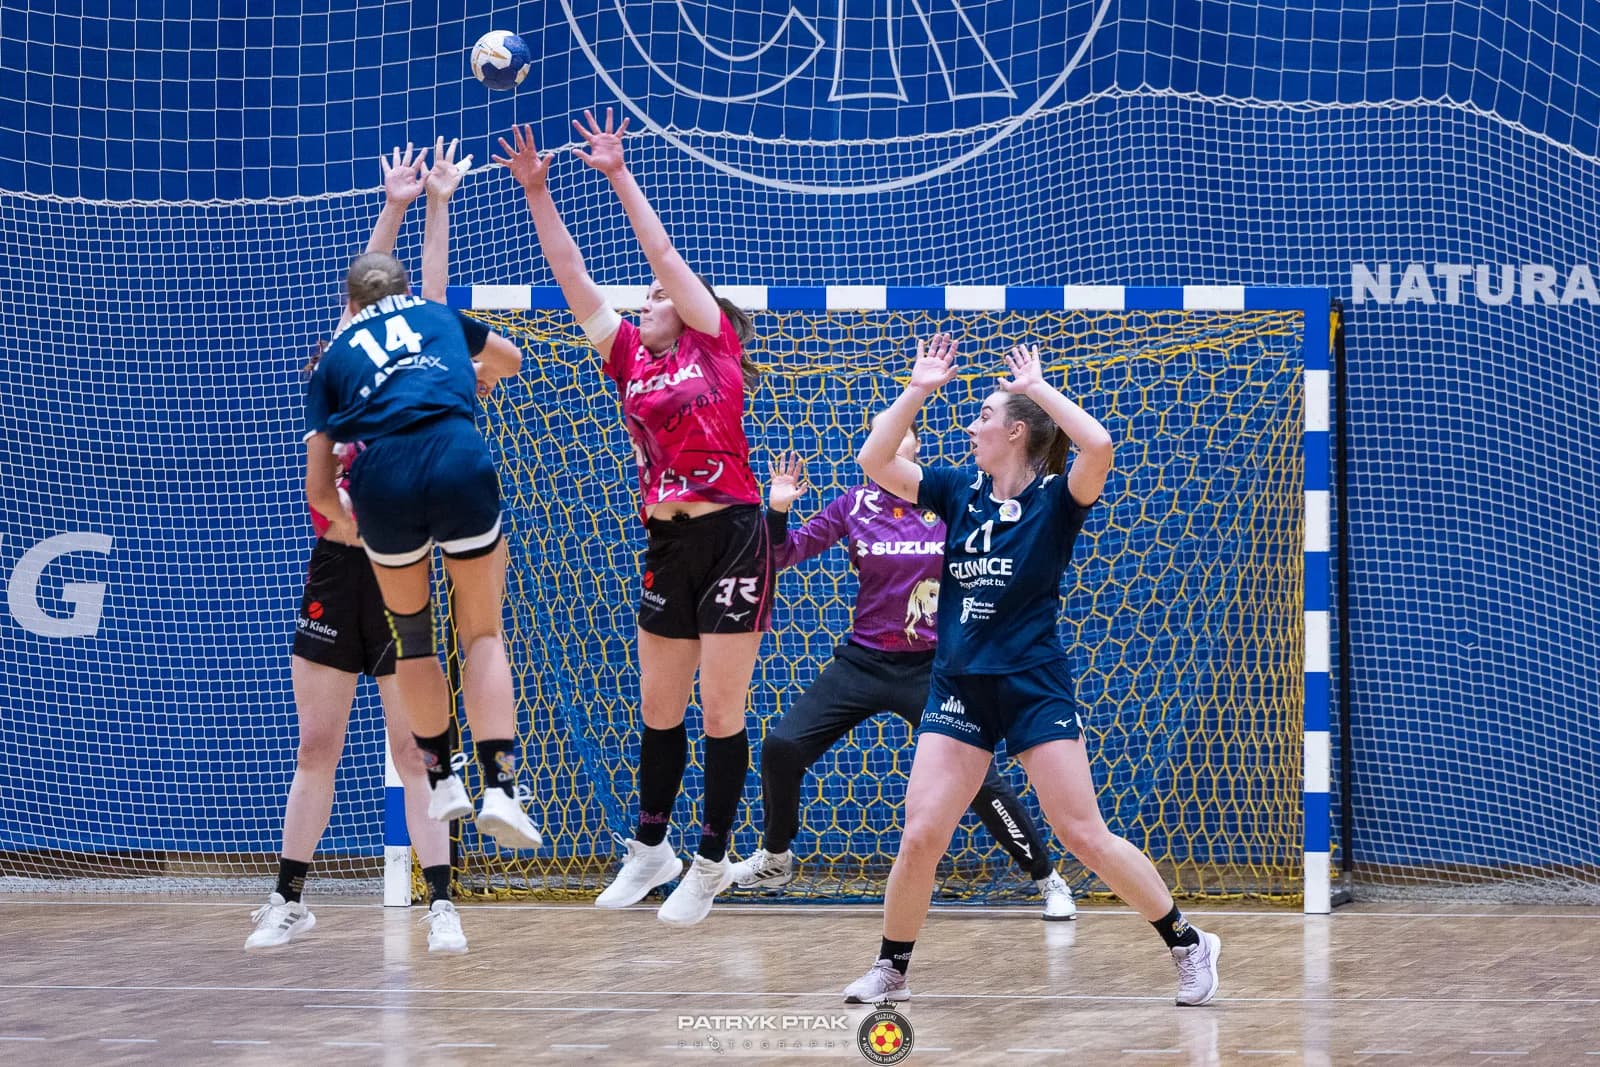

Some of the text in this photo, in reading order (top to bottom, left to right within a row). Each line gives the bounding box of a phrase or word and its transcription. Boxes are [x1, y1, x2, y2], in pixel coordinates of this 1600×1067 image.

[1351, 263, 1600, 306] NATURA
[349, 314, 424, 369] 14
[871, 541, 945, 556] SUZUK
[949, 557, 1013, 580] GLIWICE
[0, 531, 113, 638] G
[991, 798, 1025, 839] MIZUNO
